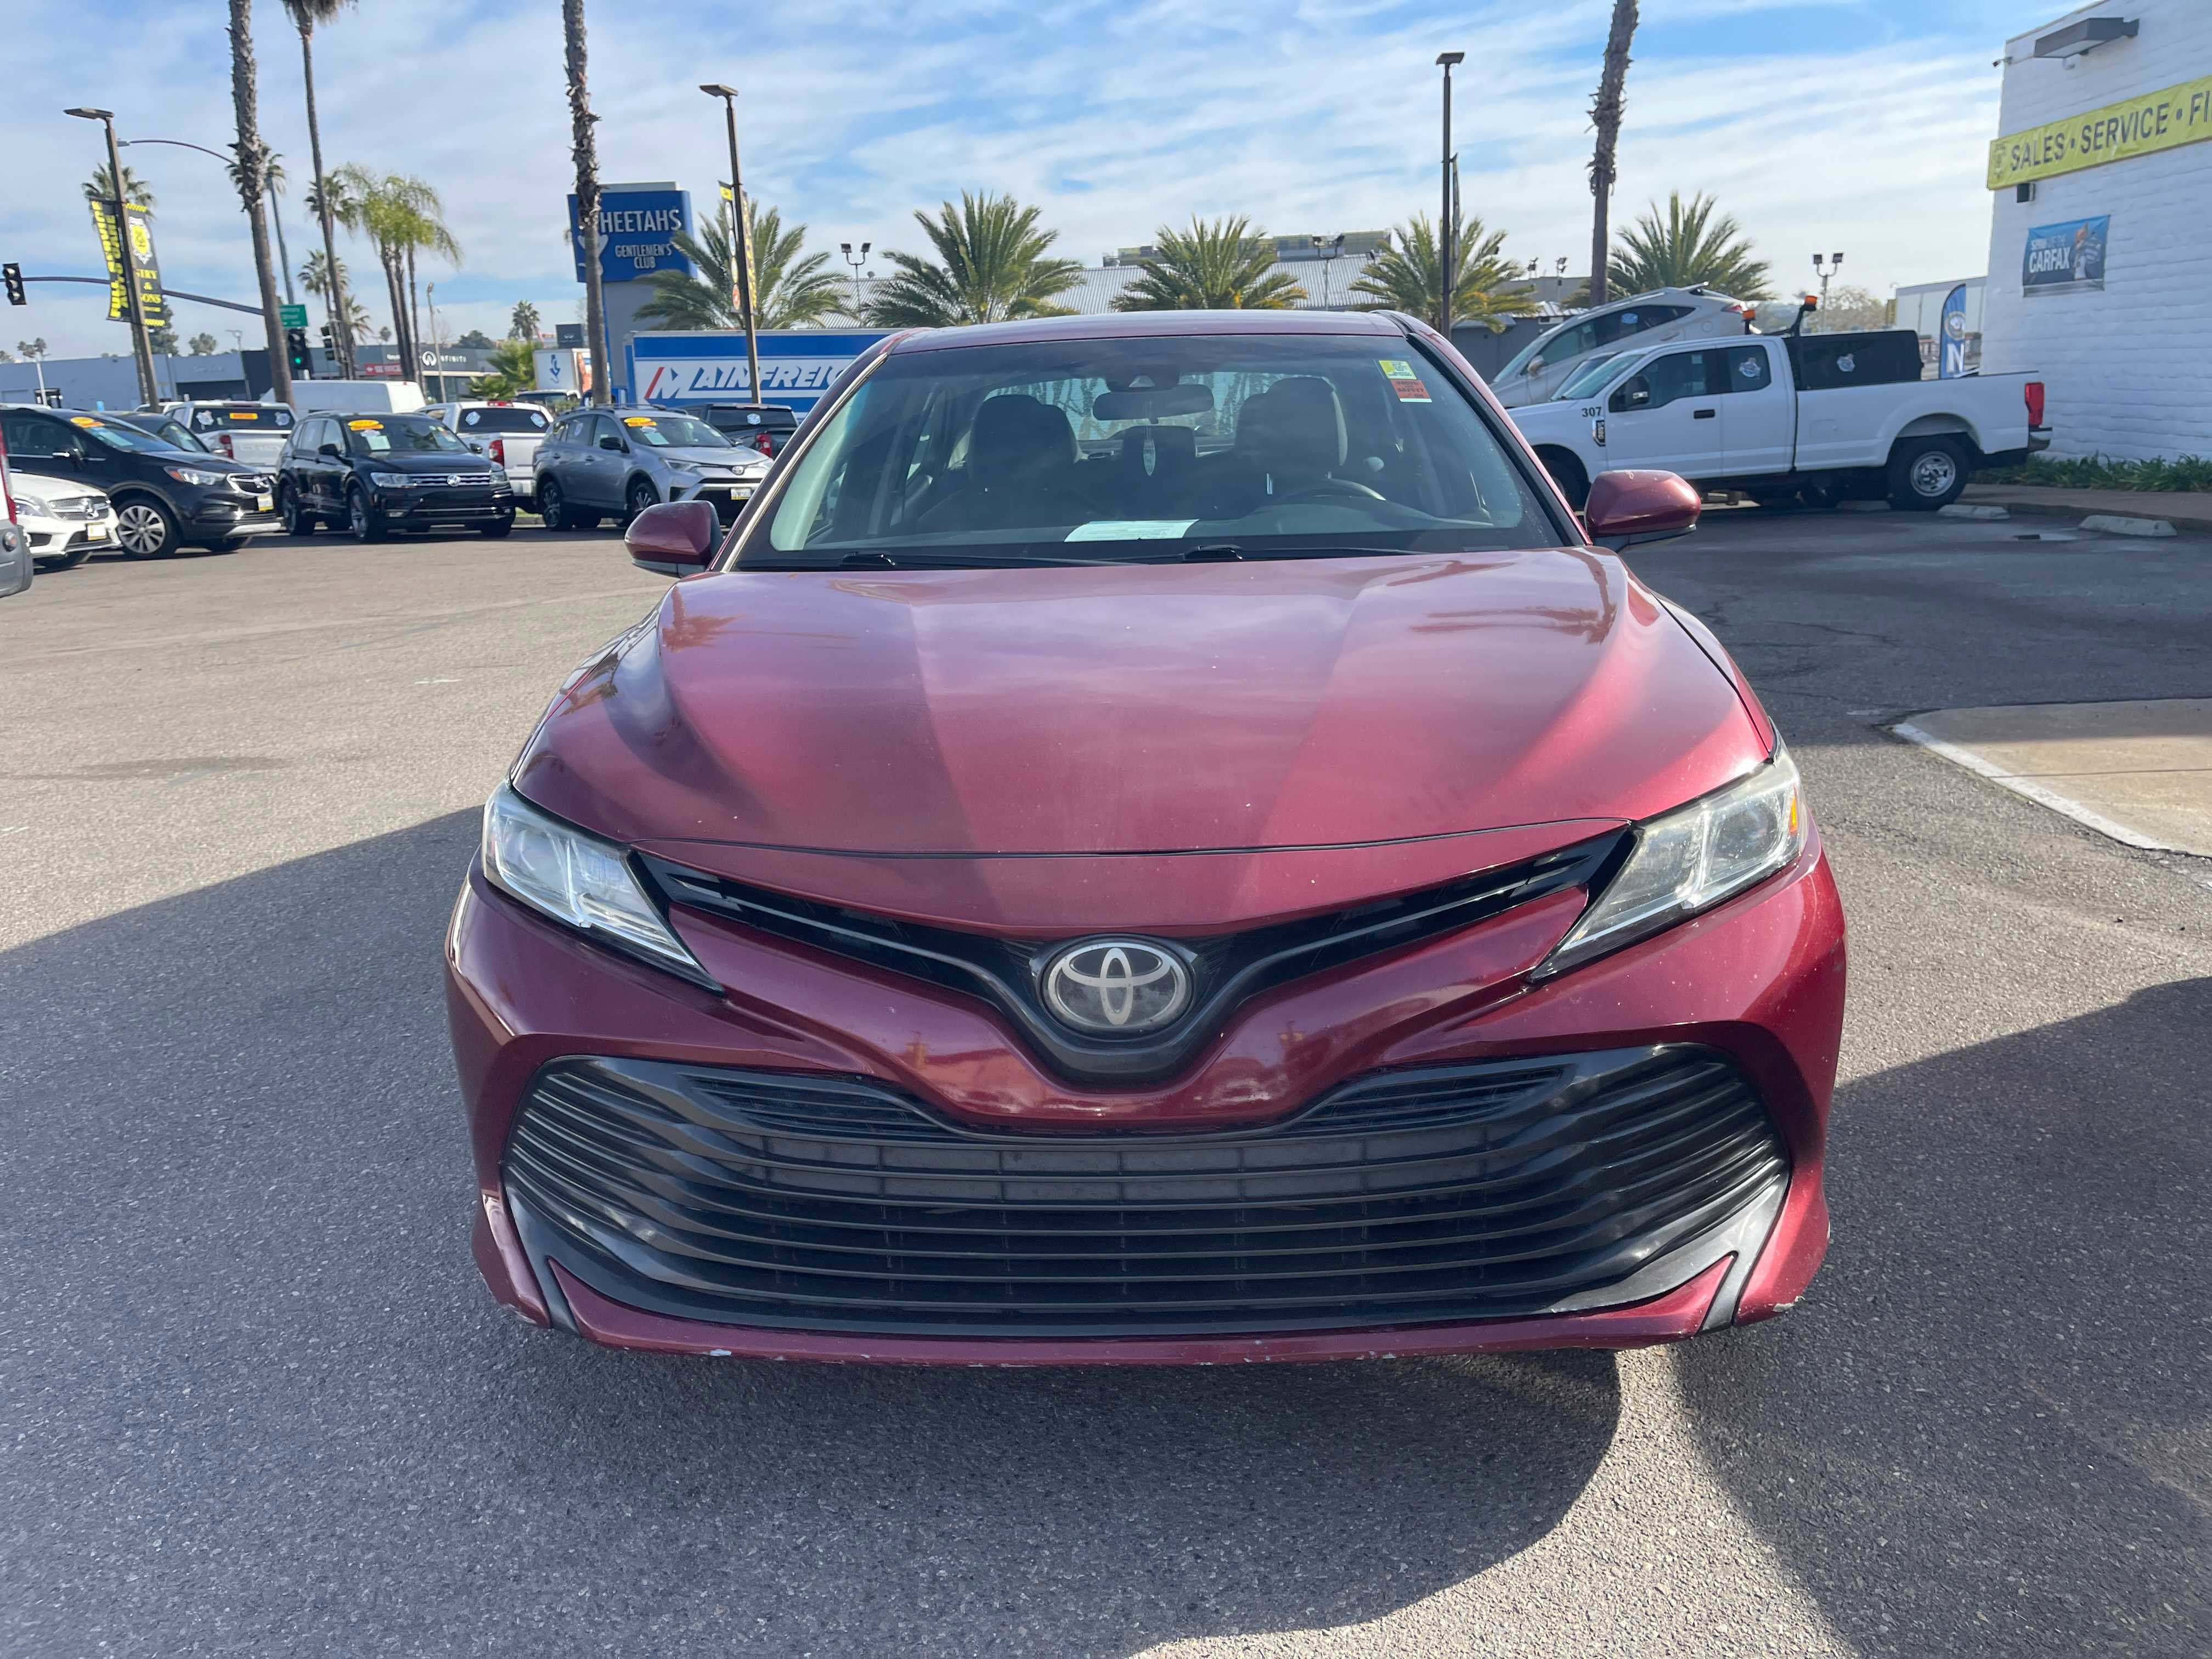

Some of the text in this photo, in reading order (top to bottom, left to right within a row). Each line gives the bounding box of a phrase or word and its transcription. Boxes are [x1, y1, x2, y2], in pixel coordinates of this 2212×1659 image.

[2010, 132, 2065, 171] SALES
[2080, 103, 2170, 154] SERVICE
[2189, 90, 2212, 126] FI
[600, 208, 682, 233] HEETAHS
[615, 243, 673, 258] GENTLEMEN'S
[2029, 246, 2070, 273] CARFAX
[634, 256, 656, 269] CLUB
[1582, 407, 1602, 417] 307
